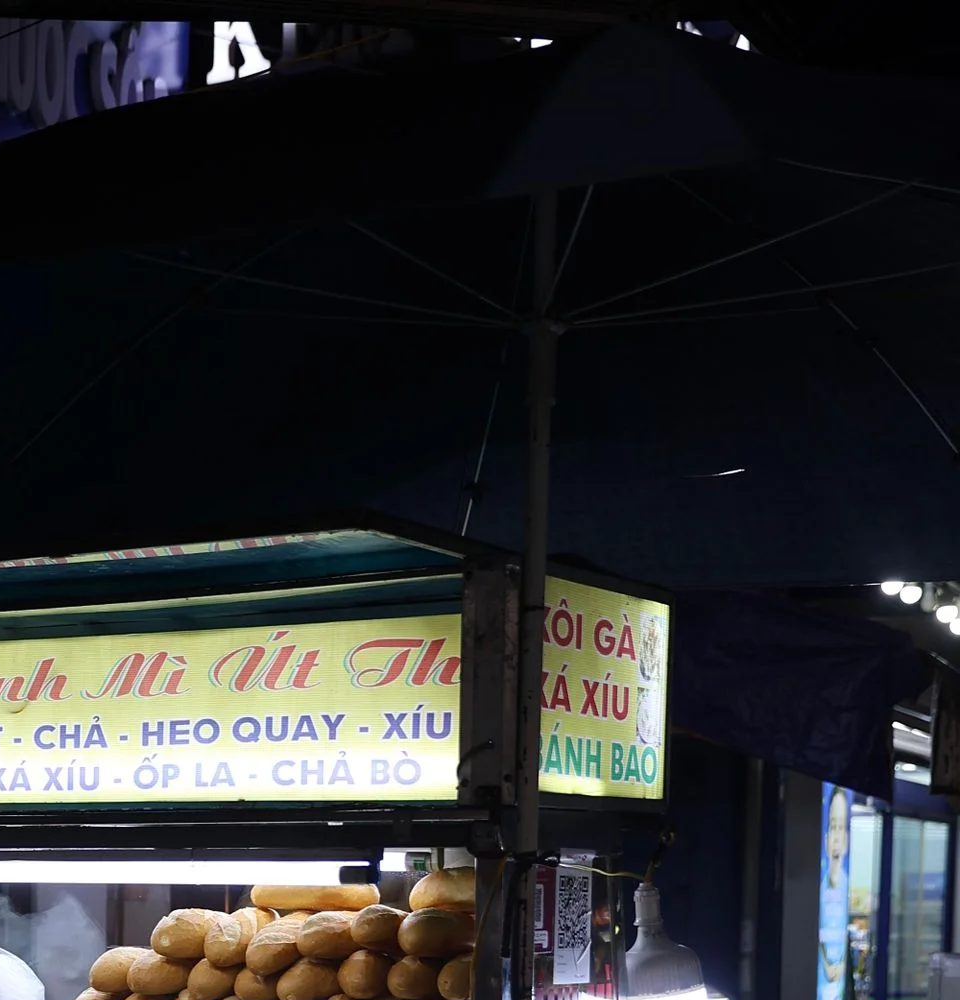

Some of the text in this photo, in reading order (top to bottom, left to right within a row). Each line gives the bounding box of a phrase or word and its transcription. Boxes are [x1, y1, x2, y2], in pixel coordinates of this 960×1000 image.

[594, 613, 636, 661] GÀ
[80, 651, 191, 698] Mì
[208, 630, 321, 693] Út
[580, 672, 630, 721] XÍU
[33, 716, 108, 750] CHẢ
[141, 718, 220, 747] HEO
[232, 714, 346, 744] QUAY
[381, 704, 452, 740] XÍU
[43, 759, 100, 792] XÍU
[133, 754, 181, 790] ỐP
[195, 762, 236, 788] LA
[271, 751, 355, 787] CHẢ
[370, 751, 422, 787] BÒ
[540, 722, 658, 785] ÁNH BAO
